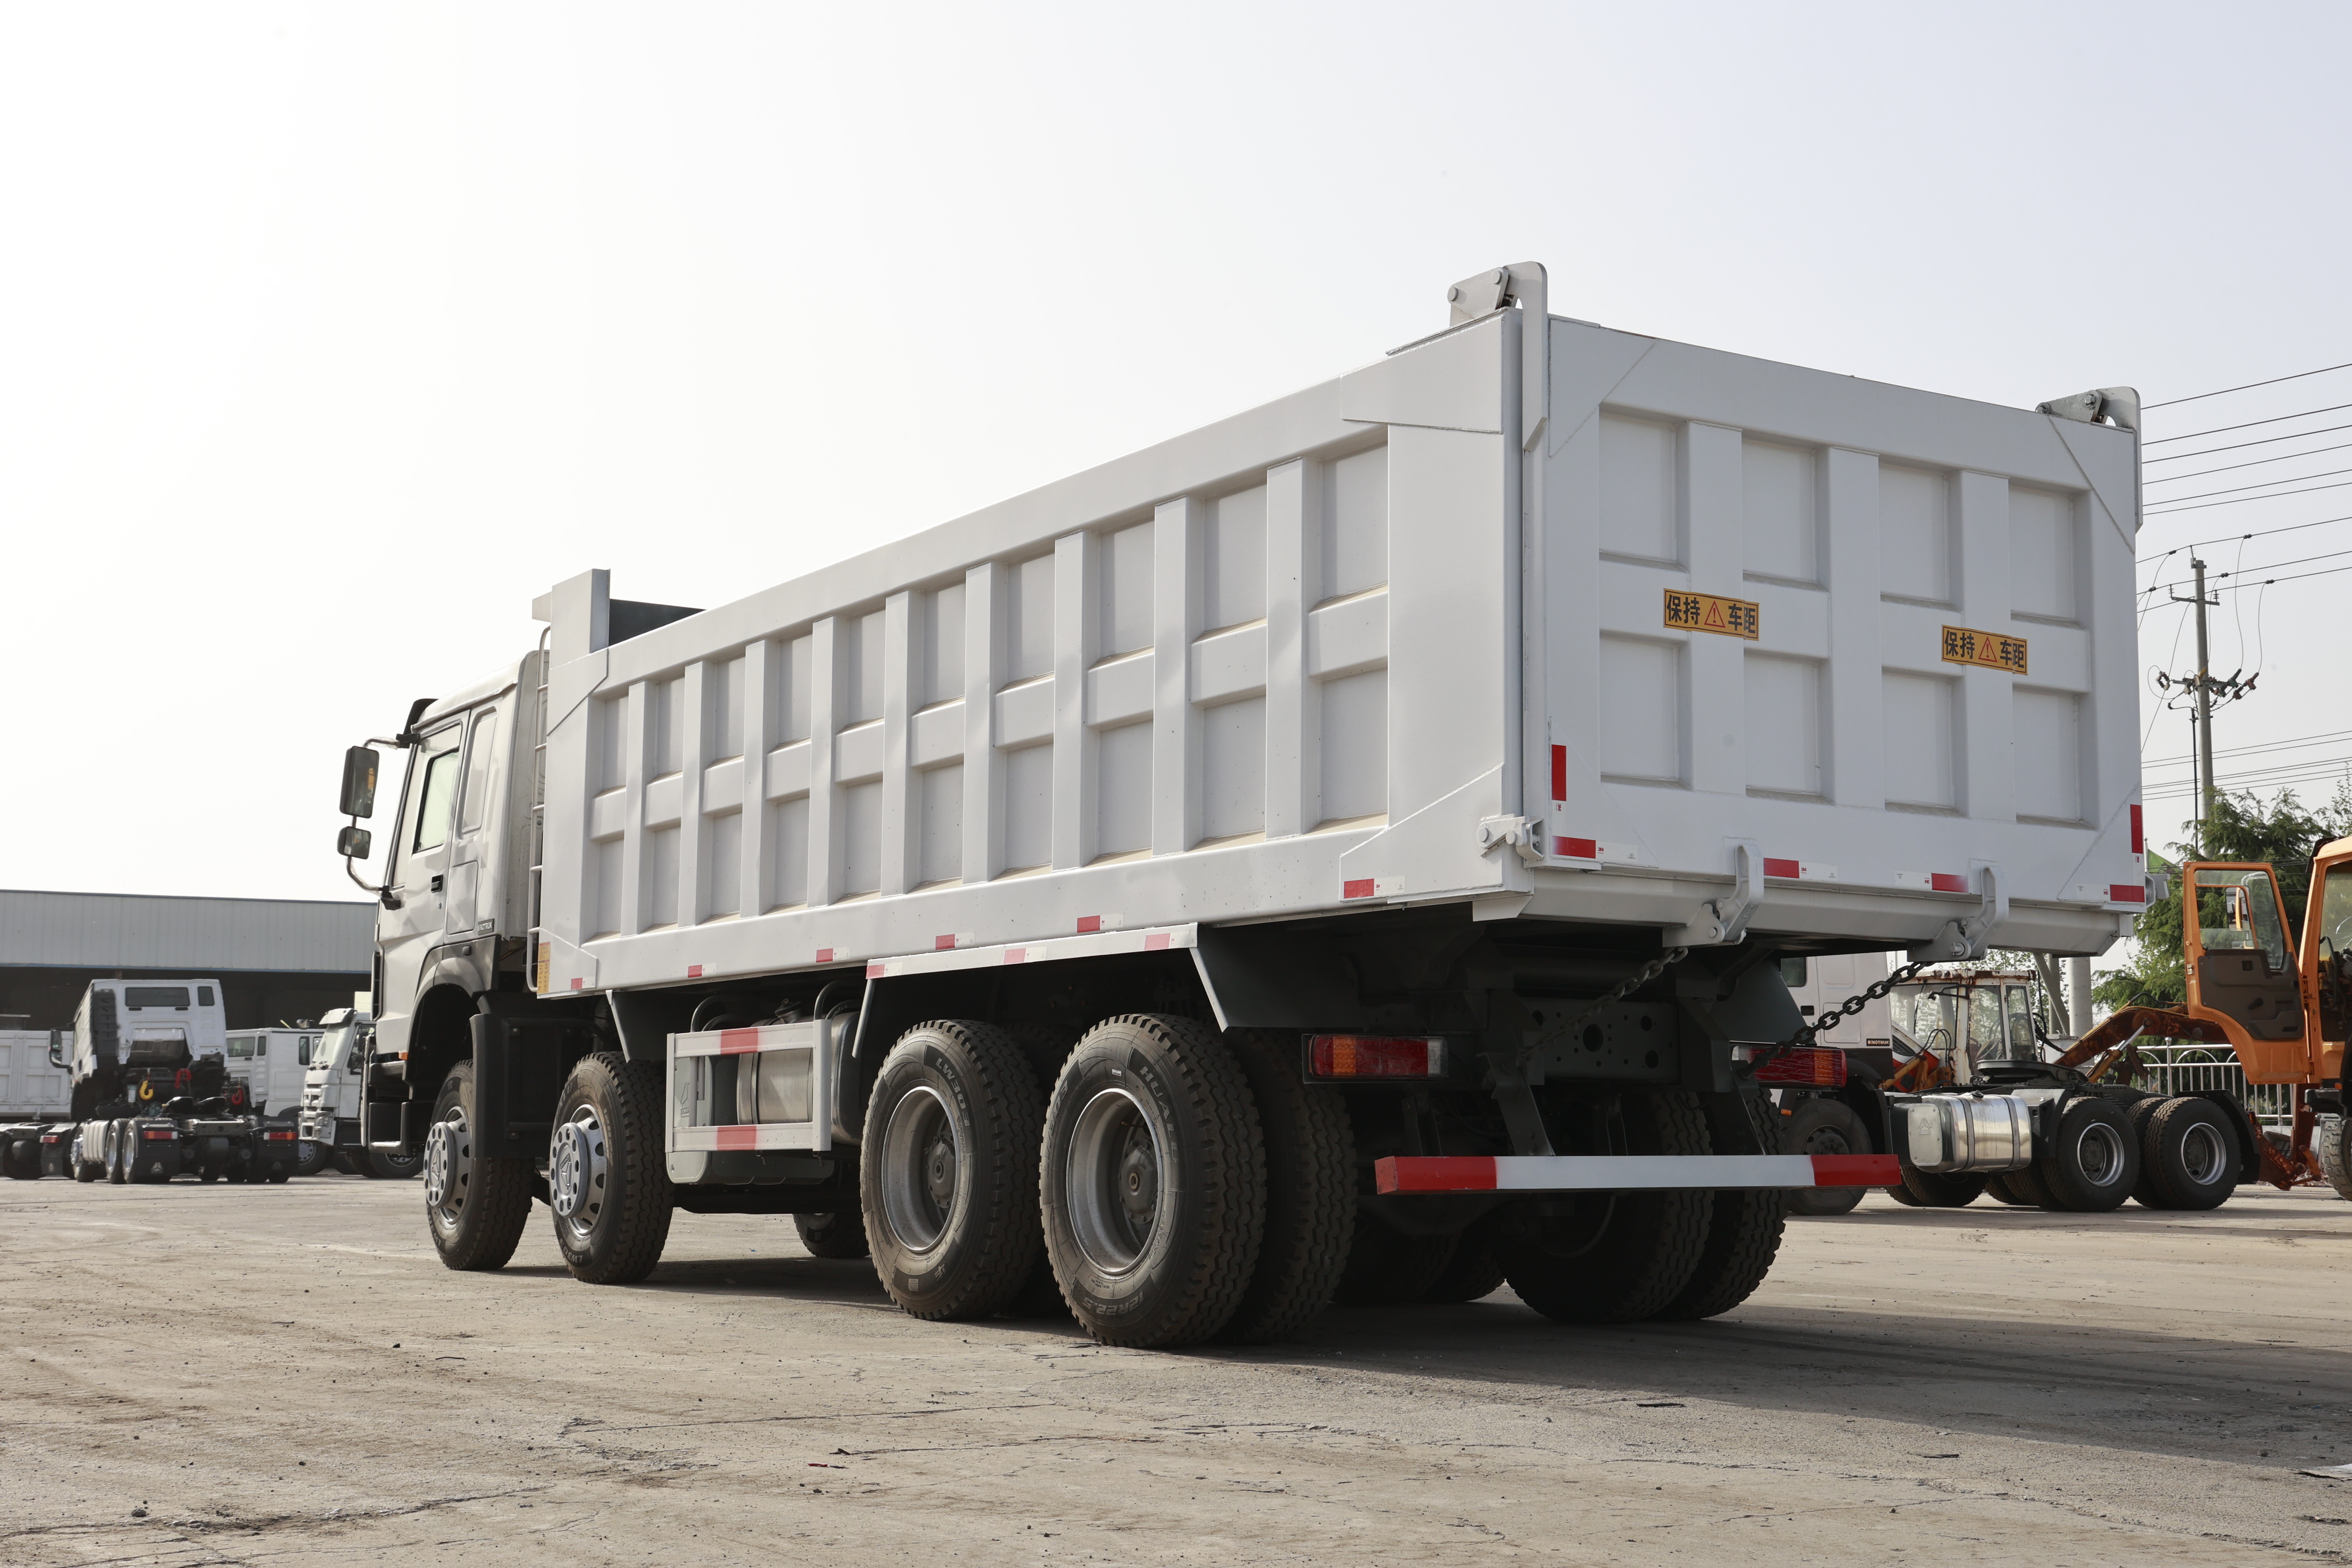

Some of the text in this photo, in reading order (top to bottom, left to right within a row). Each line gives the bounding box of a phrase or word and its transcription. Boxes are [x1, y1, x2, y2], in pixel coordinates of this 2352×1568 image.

[1666, 594, 1755, 634] 保持 车距
[1945, 630, 2024, 668] 保持 车距
[936, 1057, 971, 1127] LW303
[1139, 1066, 1180, 1165] HUALU
[559, 1238, 583, 1263] LW303
[1082, 1291, 1144, 1316] 12R22.5
